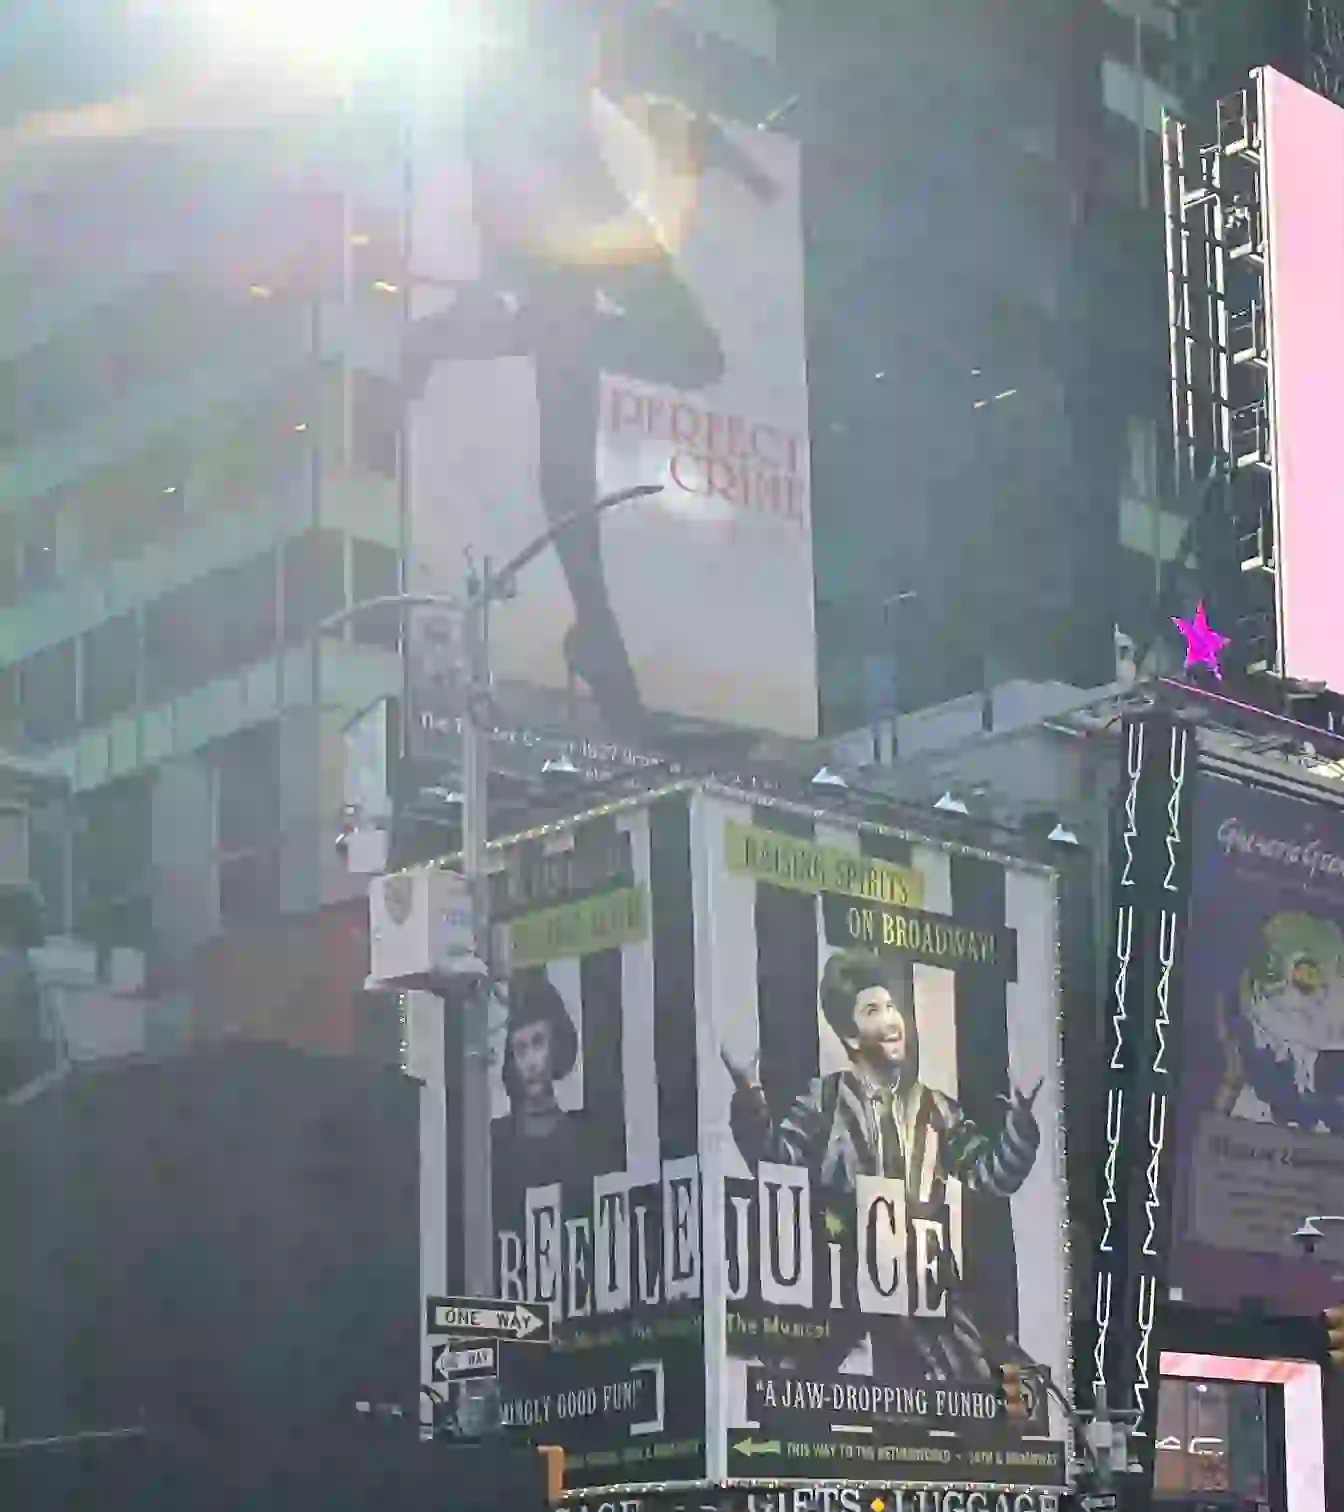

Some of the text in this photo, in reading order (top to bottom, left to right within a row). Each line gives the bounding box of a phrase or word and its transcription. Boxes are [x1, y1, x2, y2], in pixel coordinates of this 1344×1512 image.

[835, 856, 909, 905] SPIRITS
[848, 906, 997, 965] ON BROADWAY!
[497, 1174, 696, 1318] BEETLE
[445, 1308, 482, 1326] ONE
[496, 1311, 532, 1331] WAY
[557, 1388, 597, 1420] GOOD
[782, 1380, 929, 1416] JAW-DROPPING
[935, 1388, 1000, 1419] FUNHO
